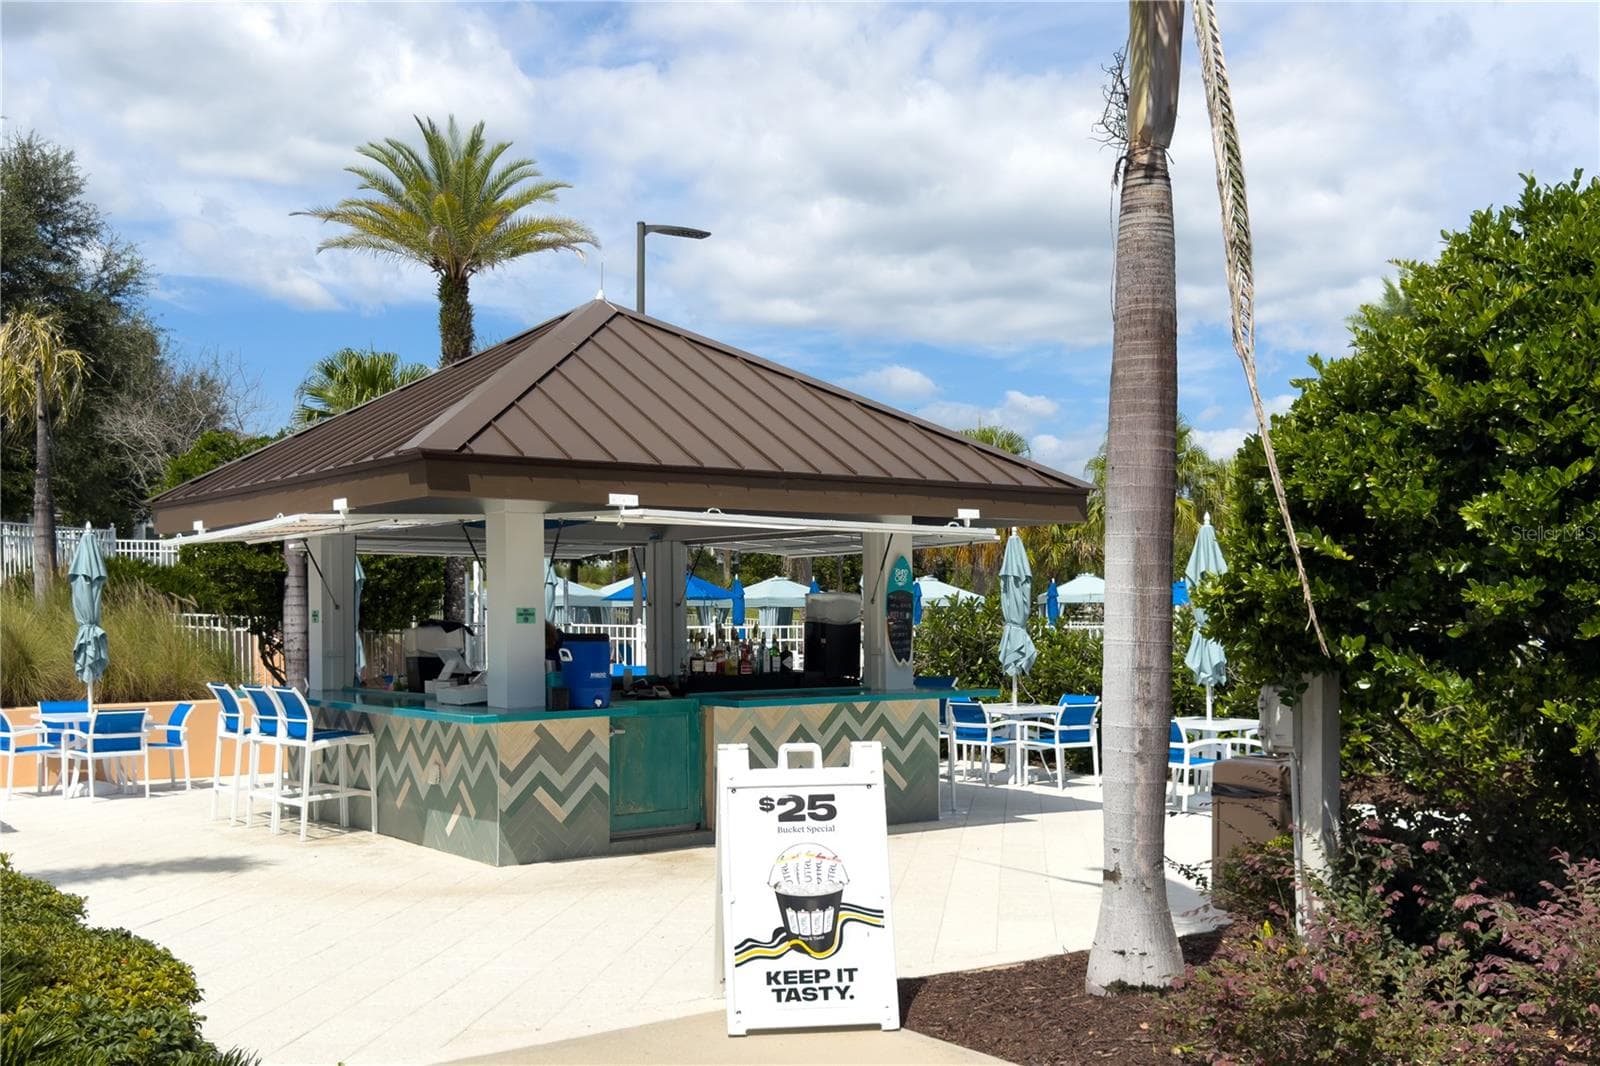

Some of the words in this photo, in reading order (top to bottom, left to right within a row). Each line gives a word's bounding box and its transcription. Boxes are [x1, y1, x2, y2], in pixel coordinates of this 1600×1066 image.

[759, 794, 837, 822] $25
[777, 825, 805, 834] Bucket
[806, 825, 835, 834] Special
[766, 968, 831, 986] KEEP
[837, 967, 859, 983] IT
[771, 985, 855, 1003] TASTY.
